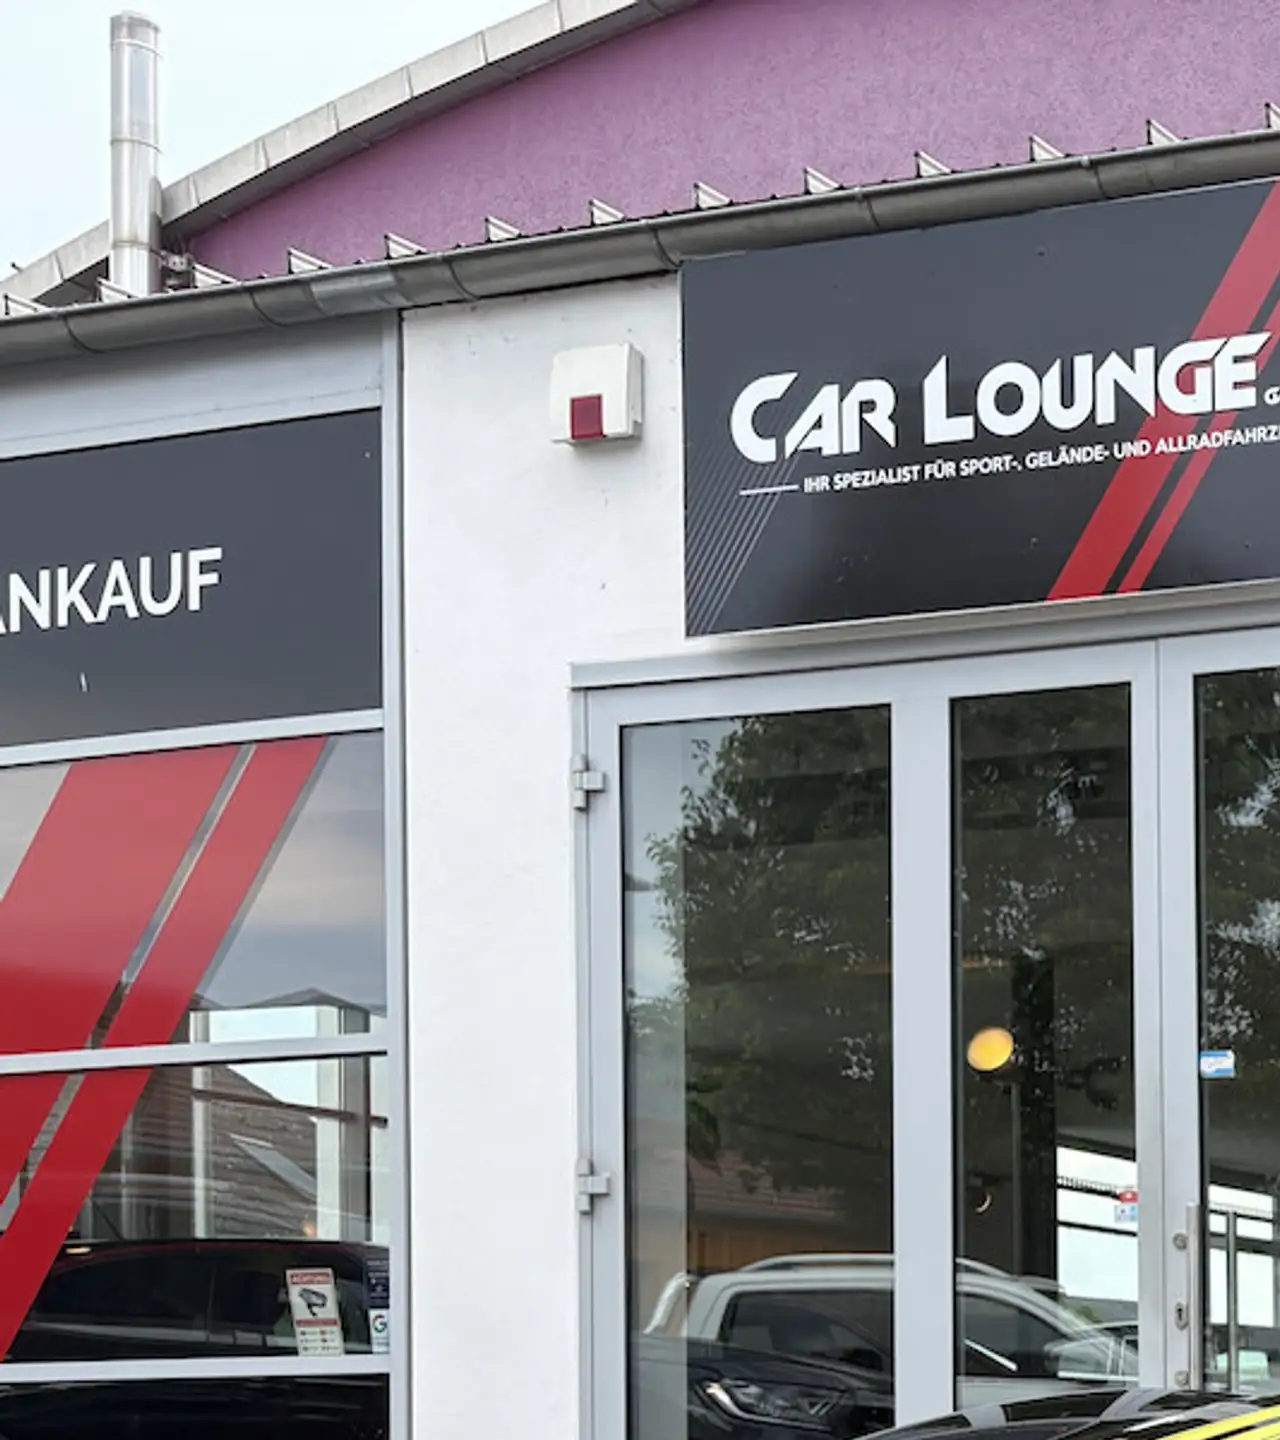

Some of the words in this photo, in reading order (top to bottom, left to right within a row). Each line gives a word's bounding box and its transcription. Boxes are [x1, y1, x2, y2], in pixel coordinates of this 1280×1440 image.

[730, 371, 896, 463] CAR
[923, 331, 1273, 445] LOUNGE
[803, 475, 830, 493] IHR
[833, 465, 921, 491] SPEZIALIST
[923, 458, 957, 481] FÜR
[1025, 444, 1110, 469] GELÄNDE-
[1113, 439, 1152, 460] UND
[0, 547, 223, 634] NKAUF
